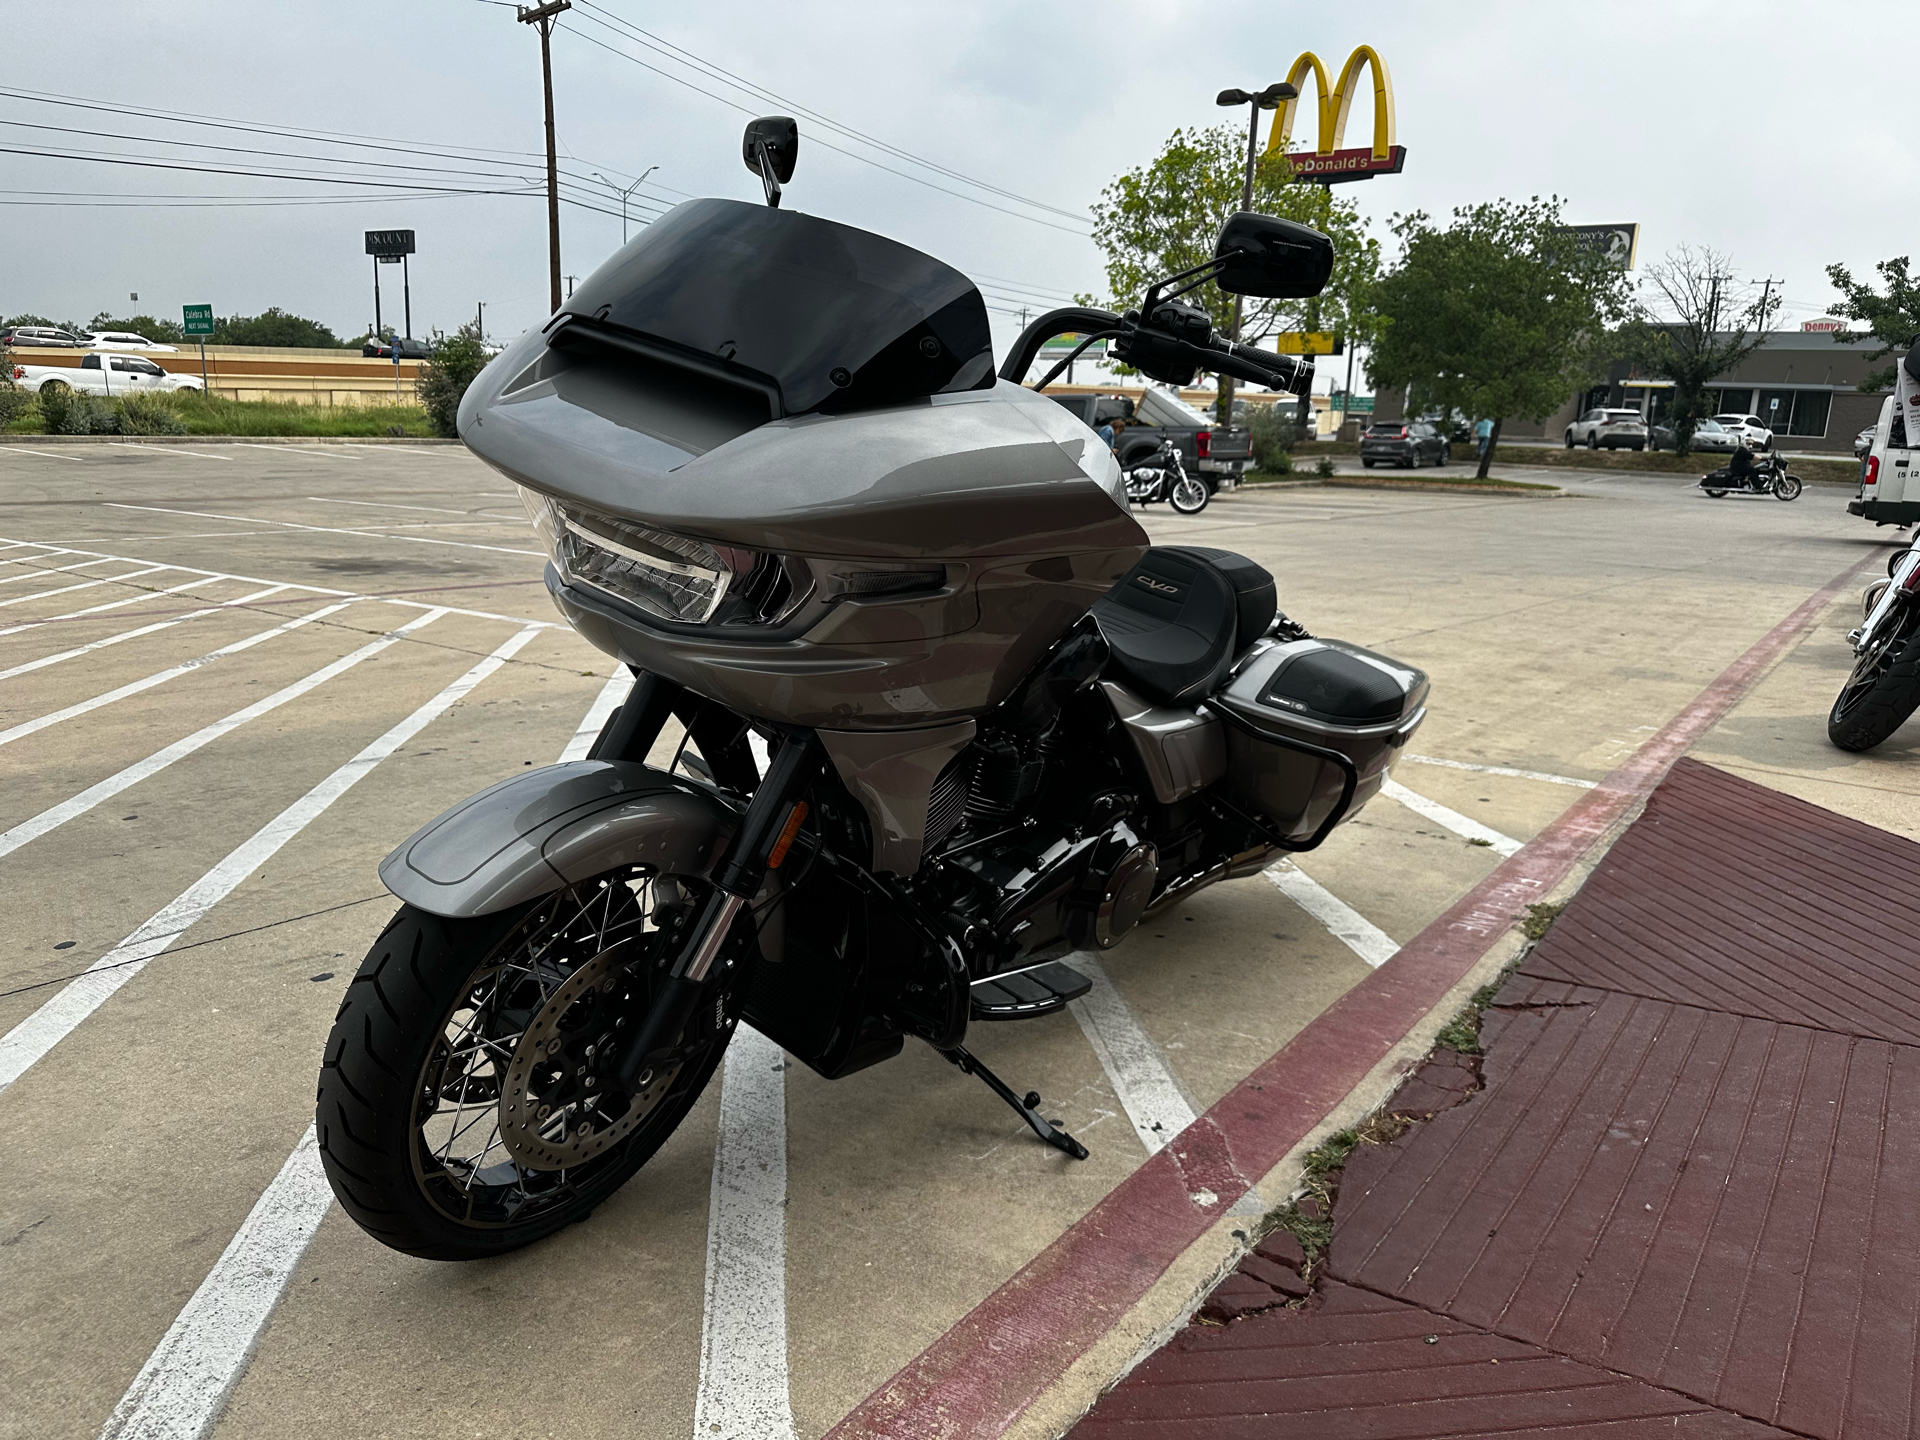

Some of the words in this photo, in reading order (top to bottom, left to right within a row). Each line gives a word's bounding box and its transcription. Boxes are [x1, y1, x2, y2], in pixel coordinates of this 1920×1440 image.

[366, 232, 408, 245] DISCOUNT
[185, 310, 203, 319] Culebra
[204, 310, 211, 319] Rd
[197, 322, 210, 330] SIGNAL
[1804, 321, 1844, 332] Denny's
